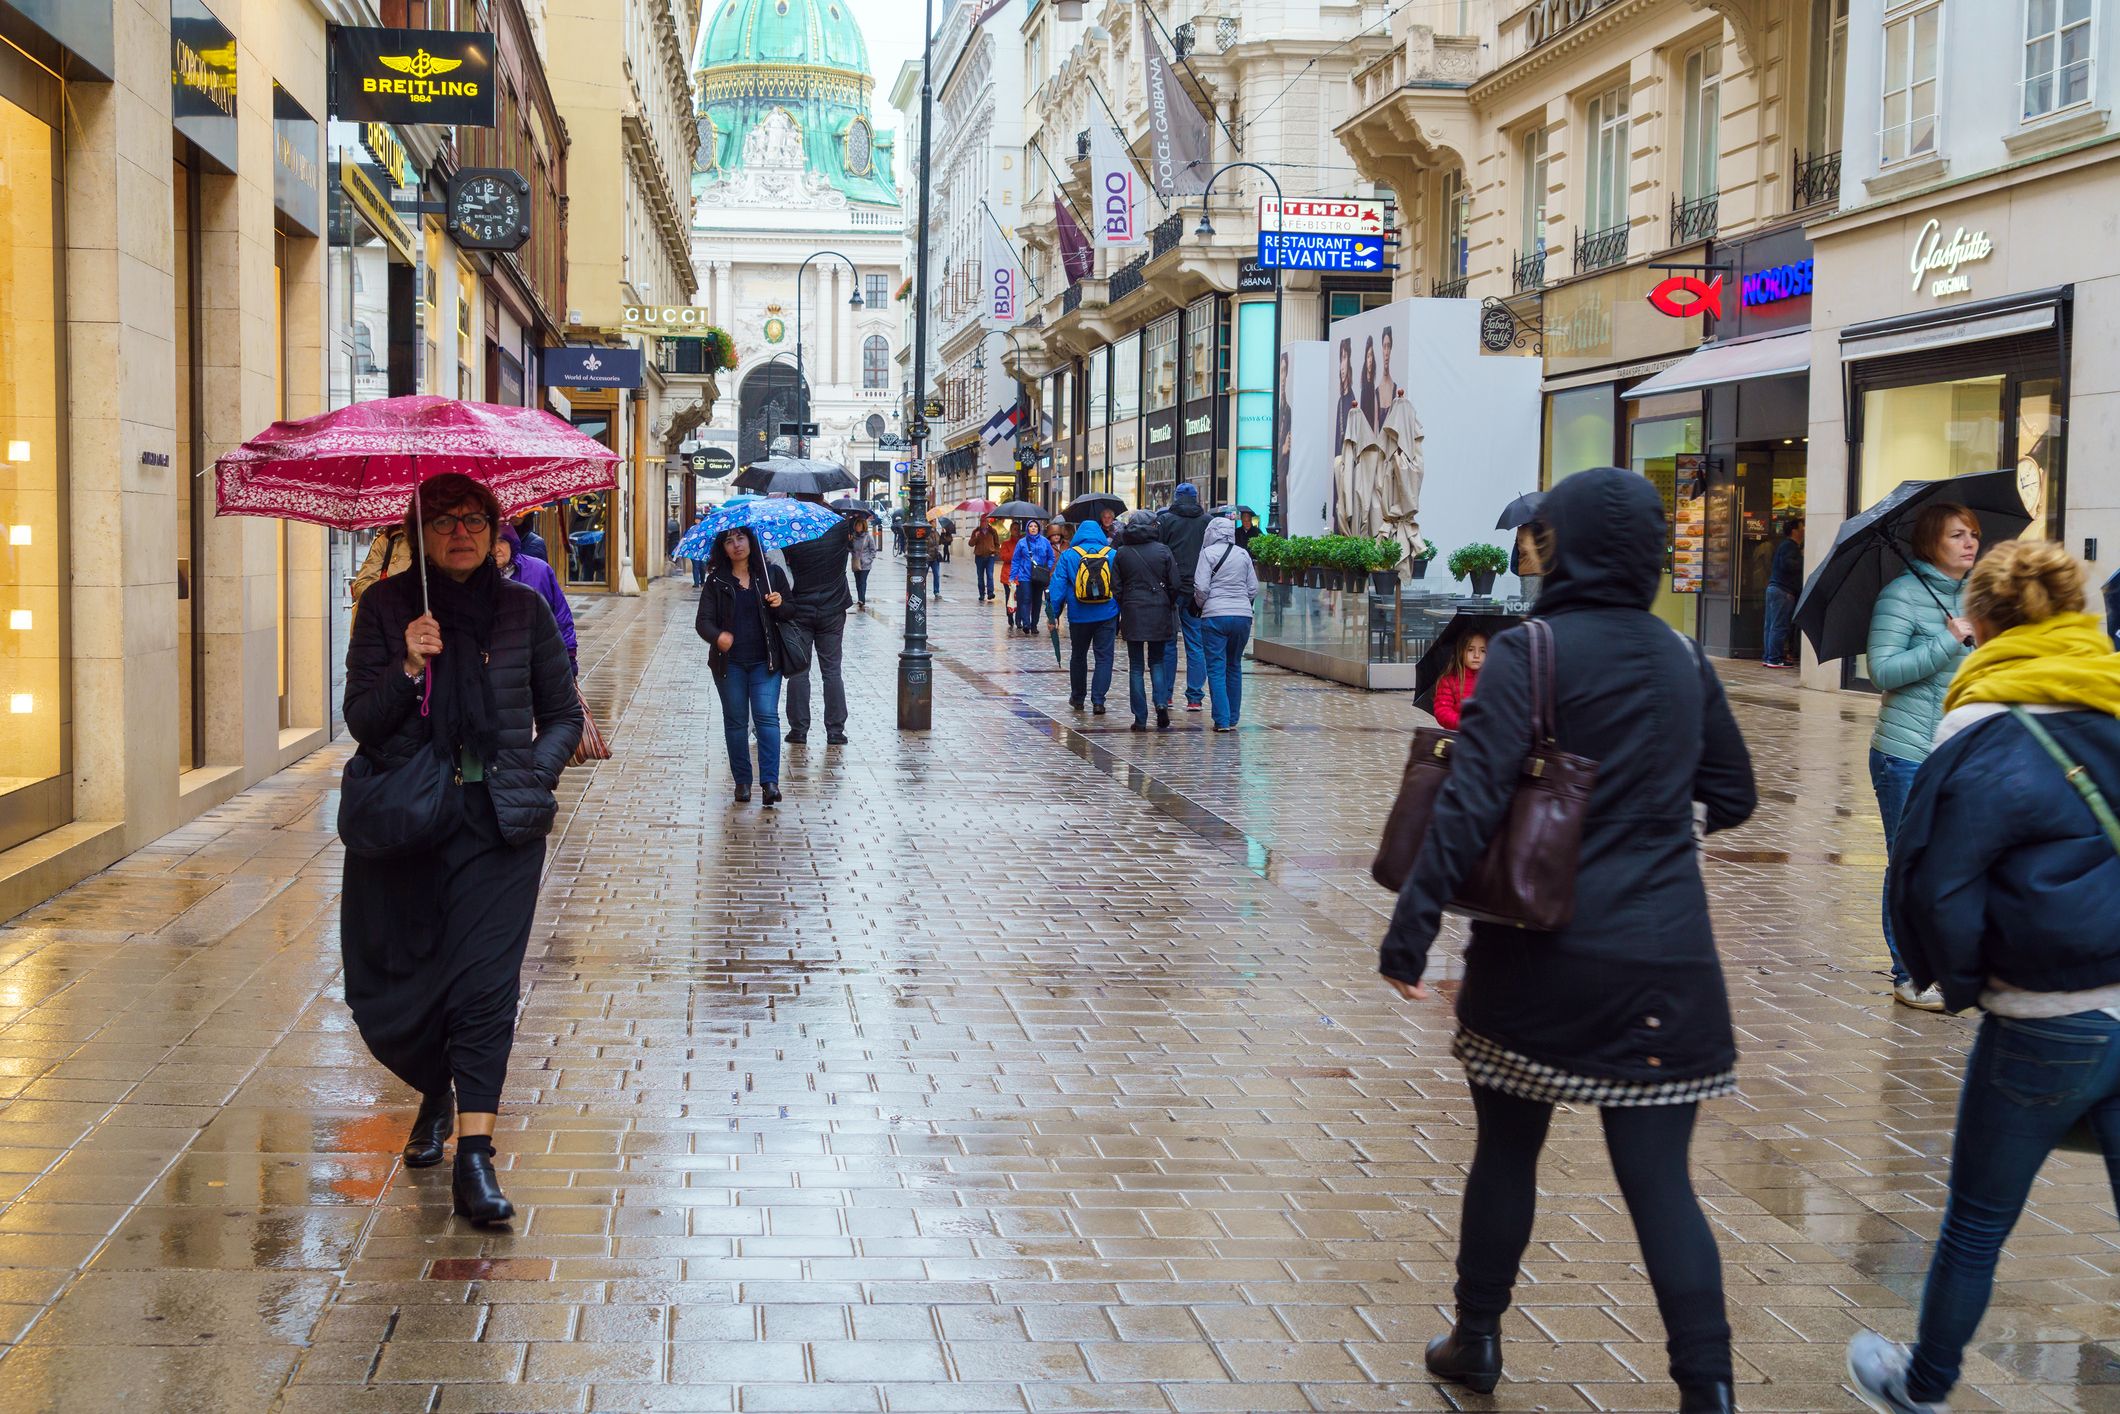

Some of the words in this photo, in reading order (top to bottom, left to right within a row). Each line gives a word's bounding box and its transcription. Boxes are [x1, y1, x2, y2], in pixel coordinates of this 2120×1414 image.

[363, 78, 478, 97] BREITLING
[1150, 56, 1169, 133] GABBANA
[410, 94, 432, 103] 1884
[1158, 141, 1174, 189] DOLCE
[484, 183, 495, 193] 12
[506, 206, 514, 215] 3
[1105, 171, 1127, 234] BDO
[1285, 203, 1357, 217] TEMPO
[484, 226, 492, 235] 6
[1264, 235, 1352, 250] RESTAURANT
[1264, 249, 1352, 268] LEVANTE
[1910, 218, 1994, 292] Glashütte
[994, 268, 1010, 314] BDO
[1932, 275, 1971, 298] ORIGINAL
[625, 307, 705, 324] GUCCI
[1483, 316, 1513, 331] Tabak
[1503, 601, 1535, 615] NOR
